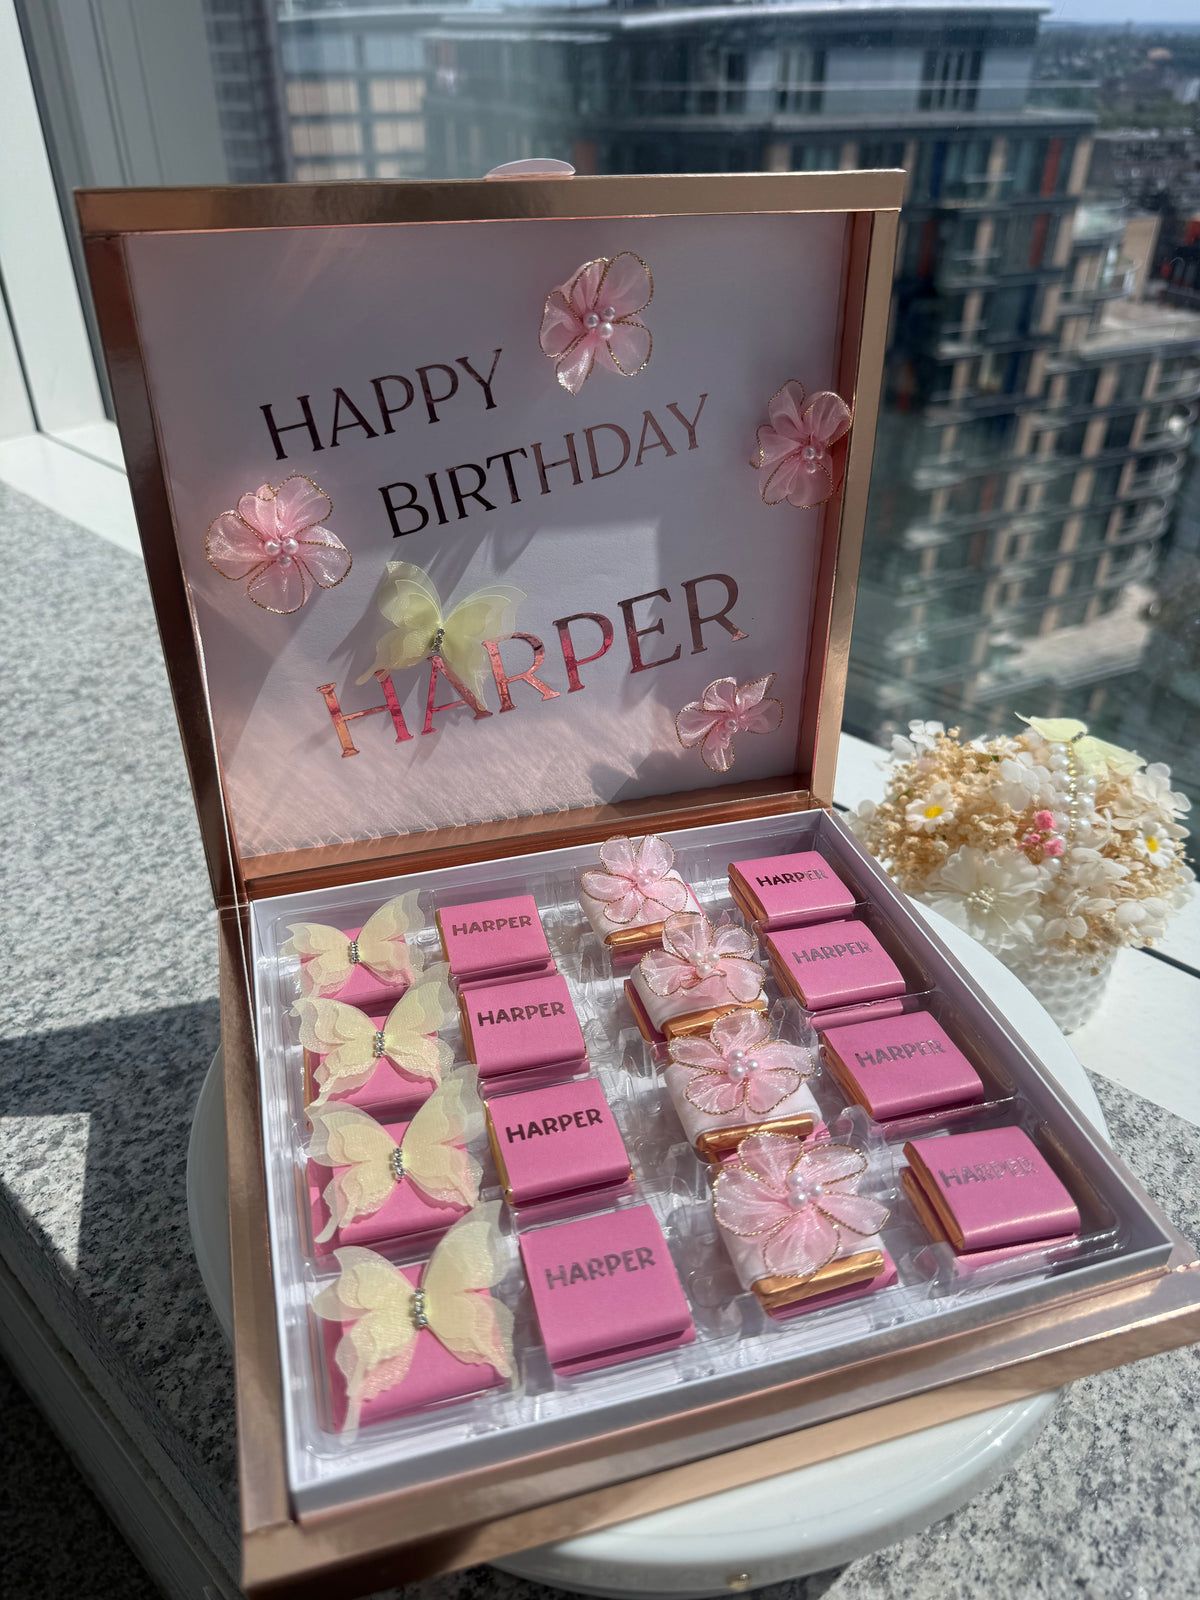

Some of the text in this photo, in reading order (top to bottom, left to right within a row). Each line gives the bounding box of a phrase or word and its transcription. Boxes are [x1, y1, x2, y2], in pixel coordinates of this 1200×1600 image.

[259, 348, 502, 460] HAPPY
[378, 393, 708, 538] BIRTHDAY
[317, 573, 749, 758] HARPER
[756, 868, 829, 887] HARPER
[452, 915, 532, 936] HARPER
[792, 940, 873, 964] HARPER
[477, 1001, 566, 1026] HARPER
[855, 1040, 945, 1067] HARPER
[505, 1108, 603, 1143] HARPER
[938, 1156, 1038, 1187] HARPER
[545, 1246, 656, 1290] HARPER
